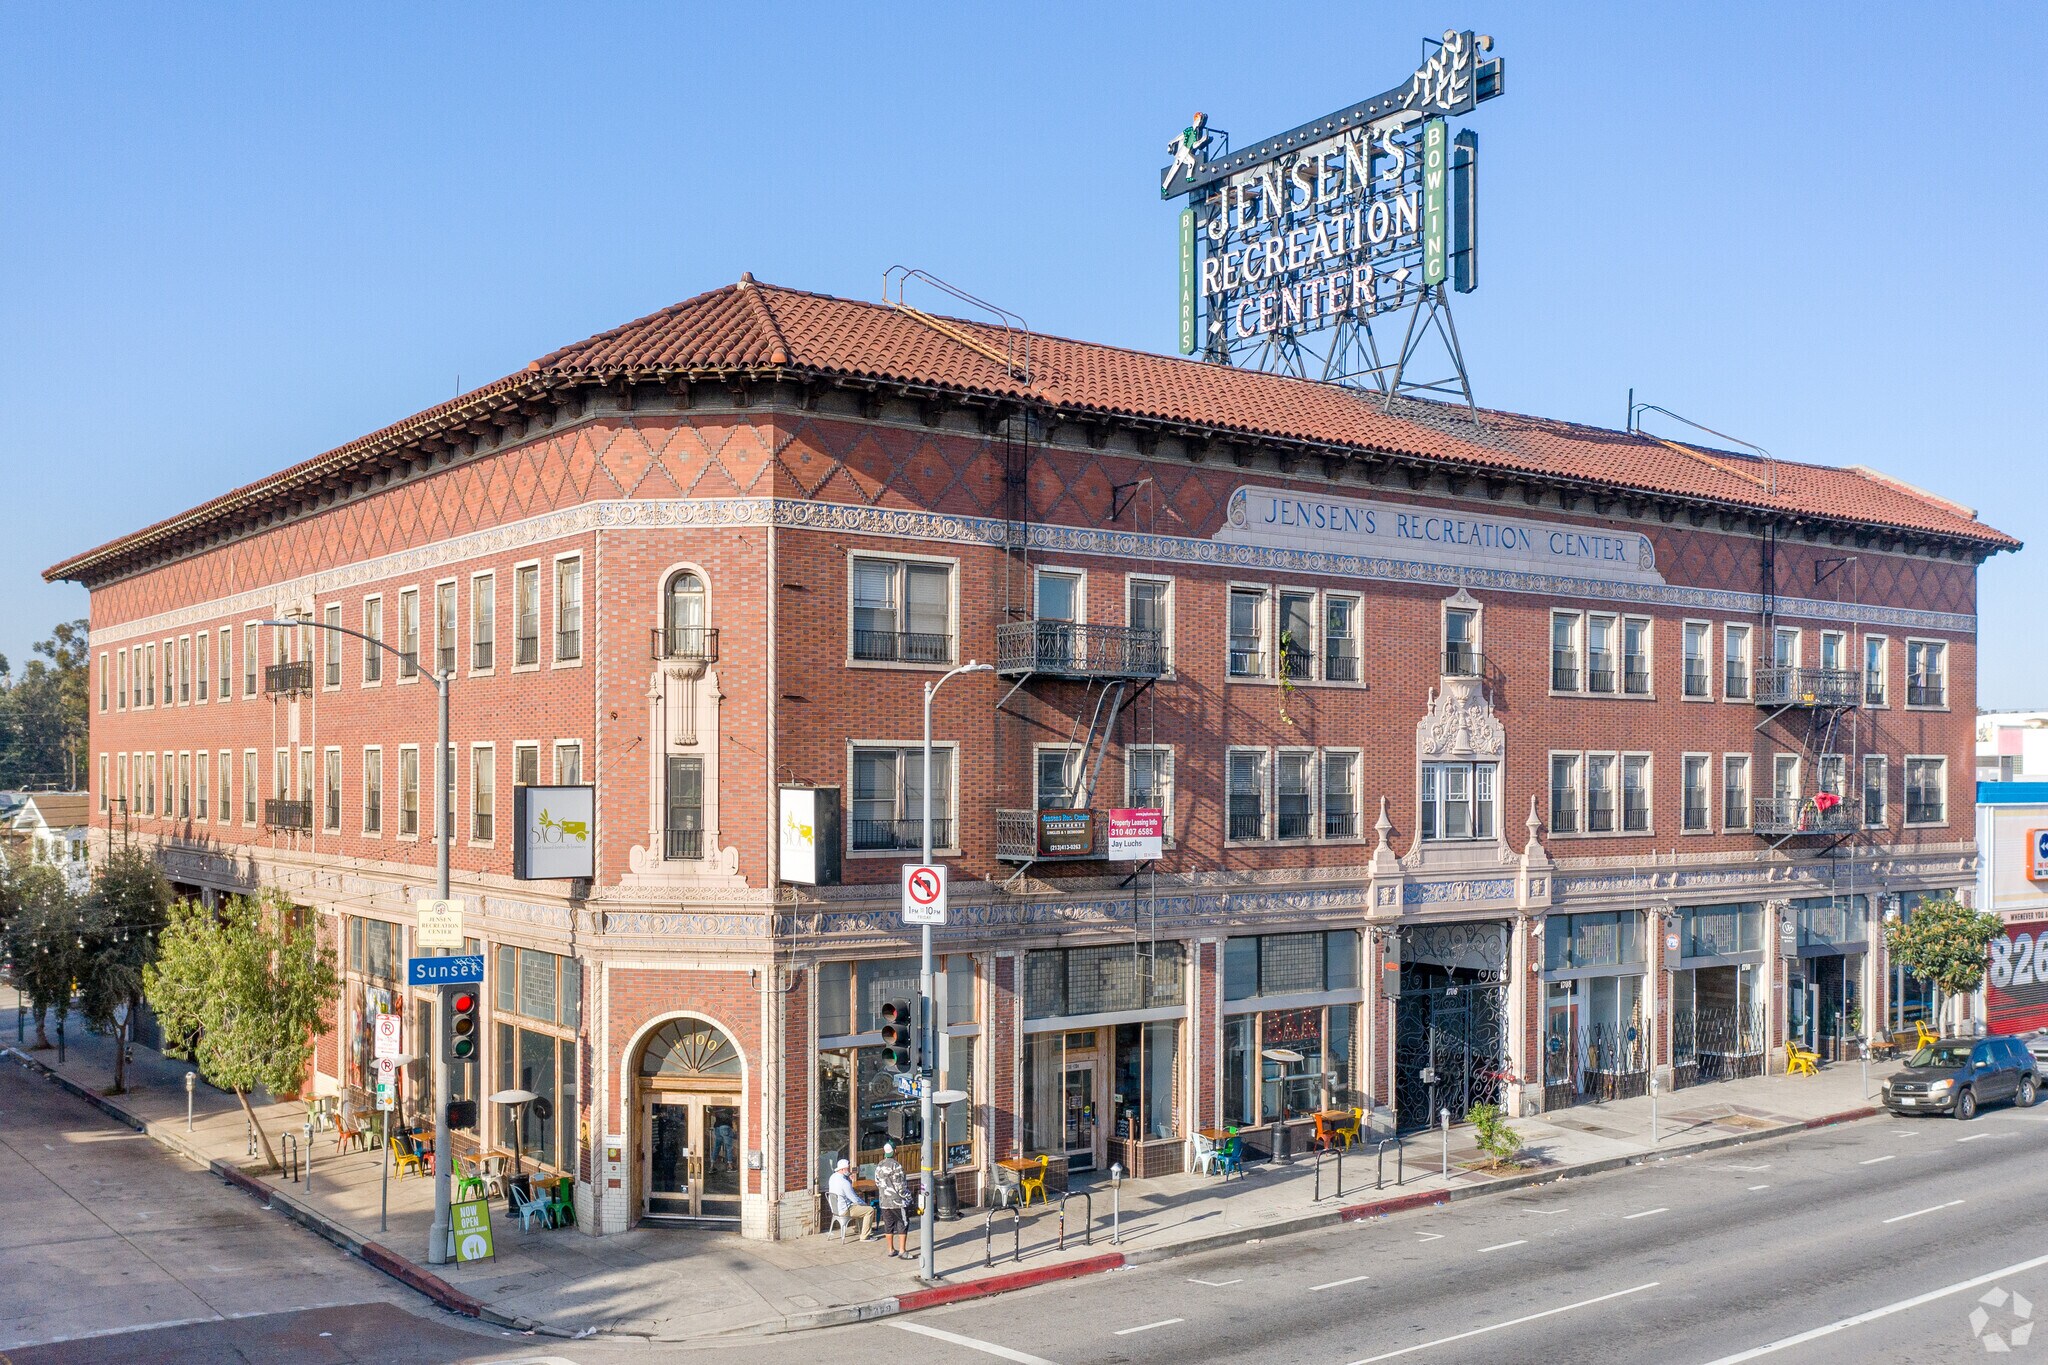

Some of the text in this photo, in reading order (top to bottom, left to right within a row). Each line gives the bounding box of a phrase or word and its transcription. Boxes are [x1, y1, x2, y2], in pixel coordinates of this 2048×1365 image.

[1207, 122, 1407, 241] JENSEN'S
[1426, 127, 1442, 277] BOWLING
[1201, 190, 1420, 298] RECREATION
[1182, 215, 1191, 349] BILLIARDS
[1235, 264, 1376, 338] CENTER
[1264, 498, 1627, 562] JENSEN'S RECREATION CENTER
[1111, 818, 1158, 828] Property Leasing Info
[1111, 840, 1123, 849] Jay
[2035, 910, 2044, 919] YOU
[416, 962, 477, 979] Sunset
[1267, 1007, 1320, 1043] BAR
[673, 1034, 717, 1051] 1700
[460, 1204, 477, 1218] NOW
[461, 1216, 479, 1229] OPEN
